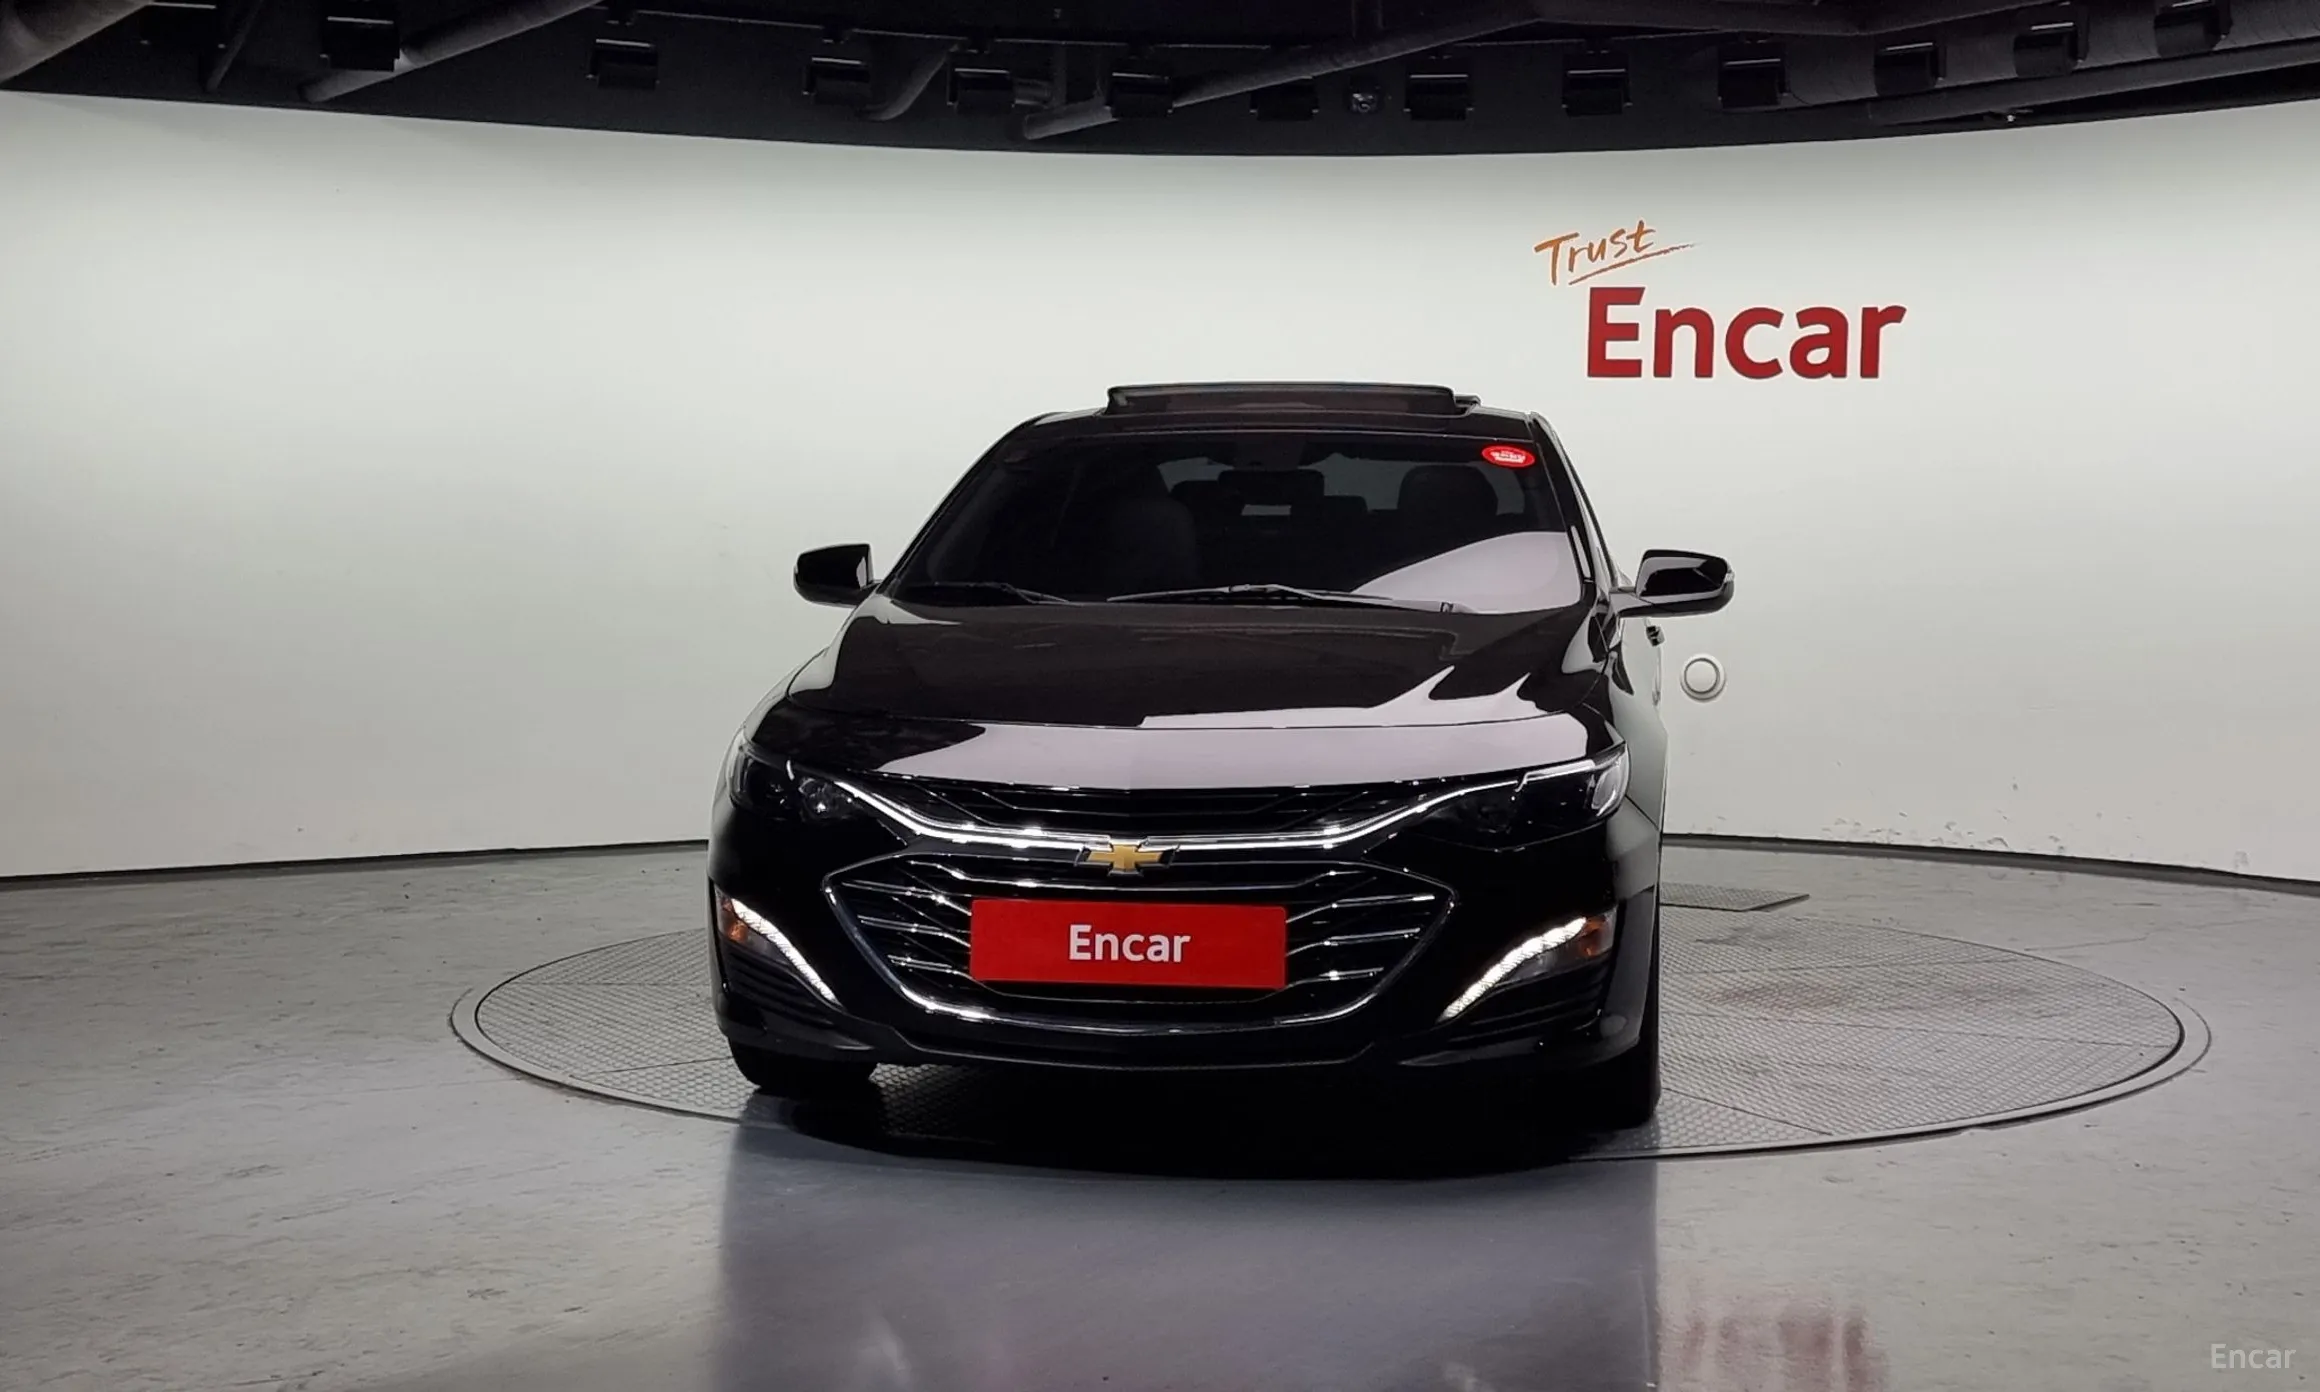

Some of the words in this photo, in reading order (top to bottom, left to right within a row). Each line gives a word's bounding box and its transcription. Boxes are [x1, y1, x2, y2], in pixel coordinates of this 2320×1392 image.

[1534, 220, 1656, 286] Trust
[1587, 286, 1907, 380] Encar
[1068, 923, 1191, 963] Encar
